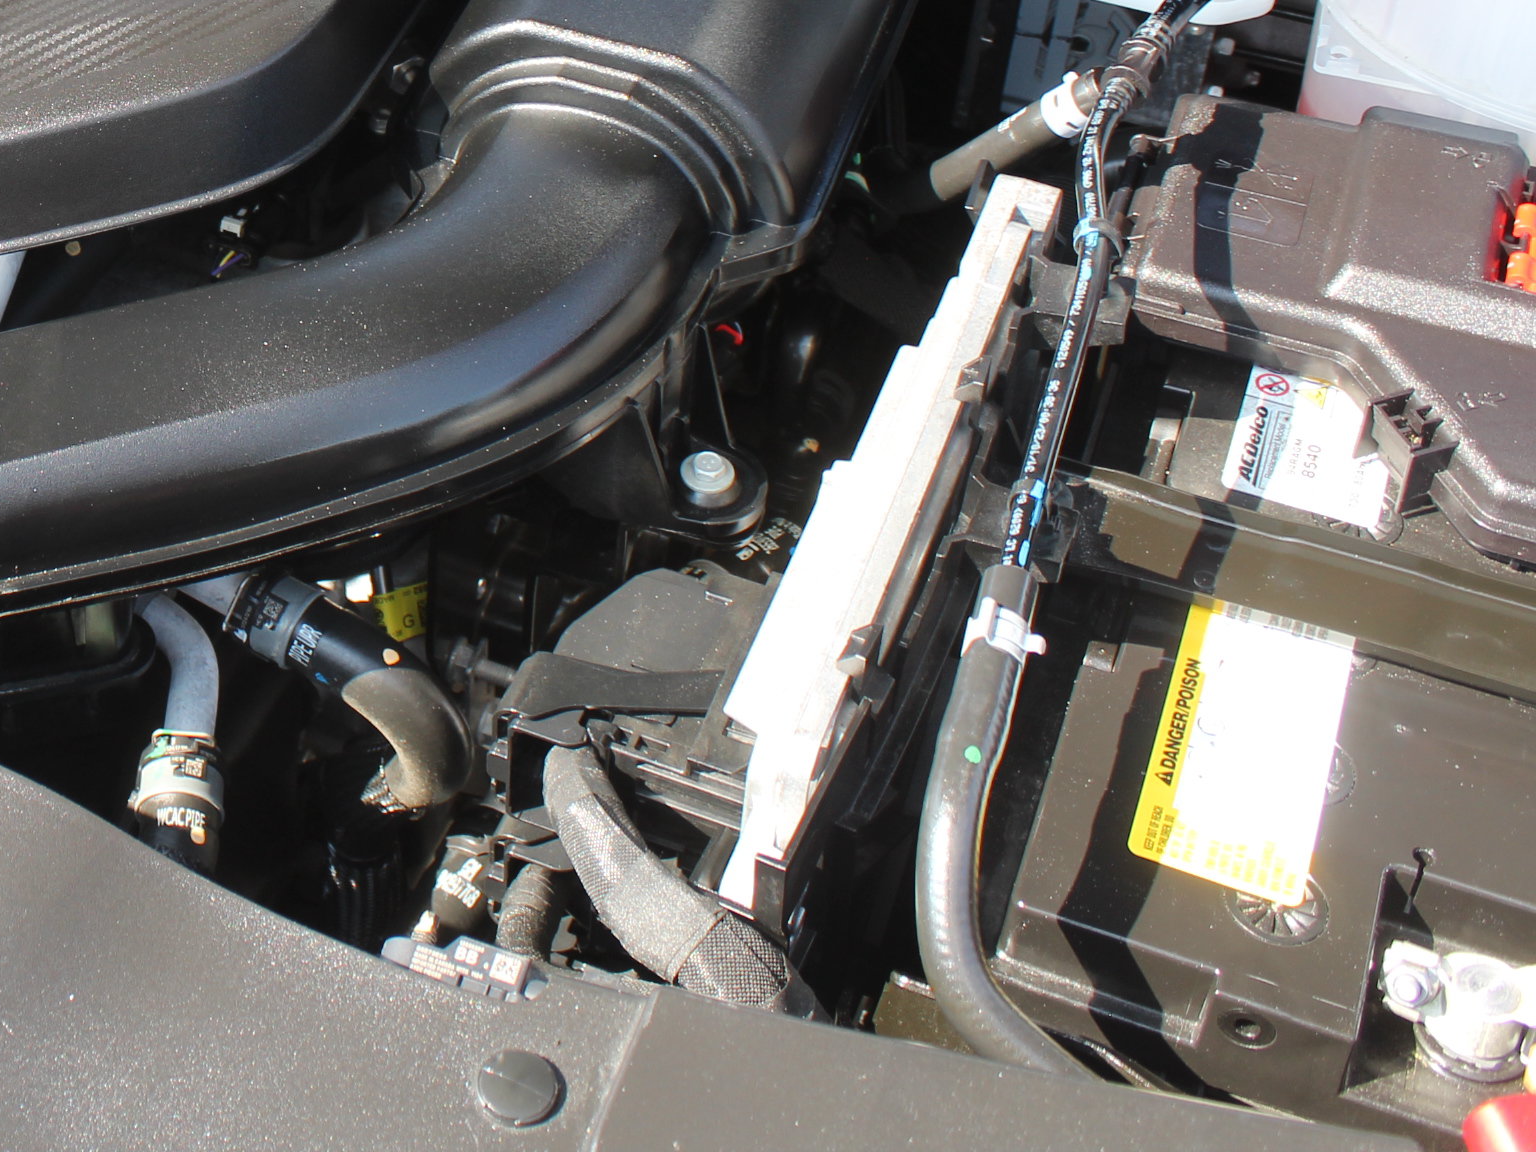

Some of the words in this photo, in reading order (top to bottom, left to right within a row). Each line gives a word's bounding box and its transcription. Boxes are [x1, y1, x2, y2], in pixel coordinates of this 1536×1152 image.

[1236, 404, 1270, 482] ACDelco
[1263, 441, 1281, 479] Replacement
[1273, 422, 1286, 442] Model
[1301, 443, 1322, 479] 8540
[301, 623, 323, 649] UPR
[402, 614, 415, 628] G
[1158, 657, 1204, 771] DANGER/POISON
[157, 807, 185, 827] WCAC
